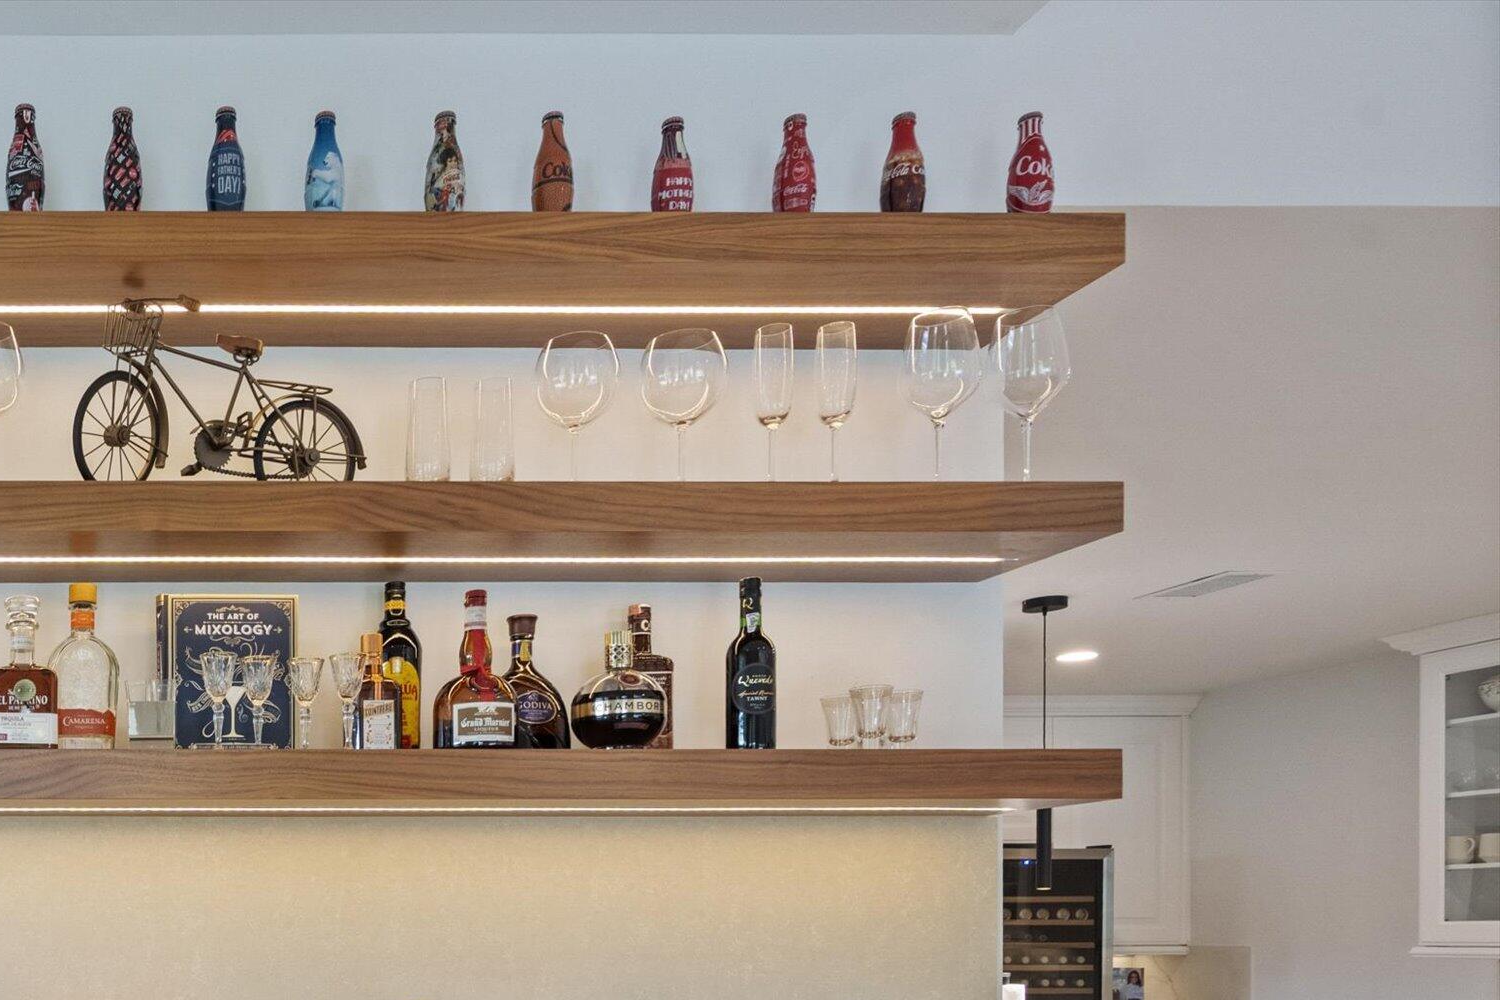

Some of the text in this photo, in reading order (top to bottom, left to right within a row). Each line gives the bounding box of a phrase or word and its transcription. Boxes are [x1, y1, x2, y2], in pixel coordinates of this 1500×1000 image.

[206, 612, 260, 620] THE ART OF
[194, 624, 274, 636] MIXOLOGY
[594, 701, 660, 712] CHAMBOR
